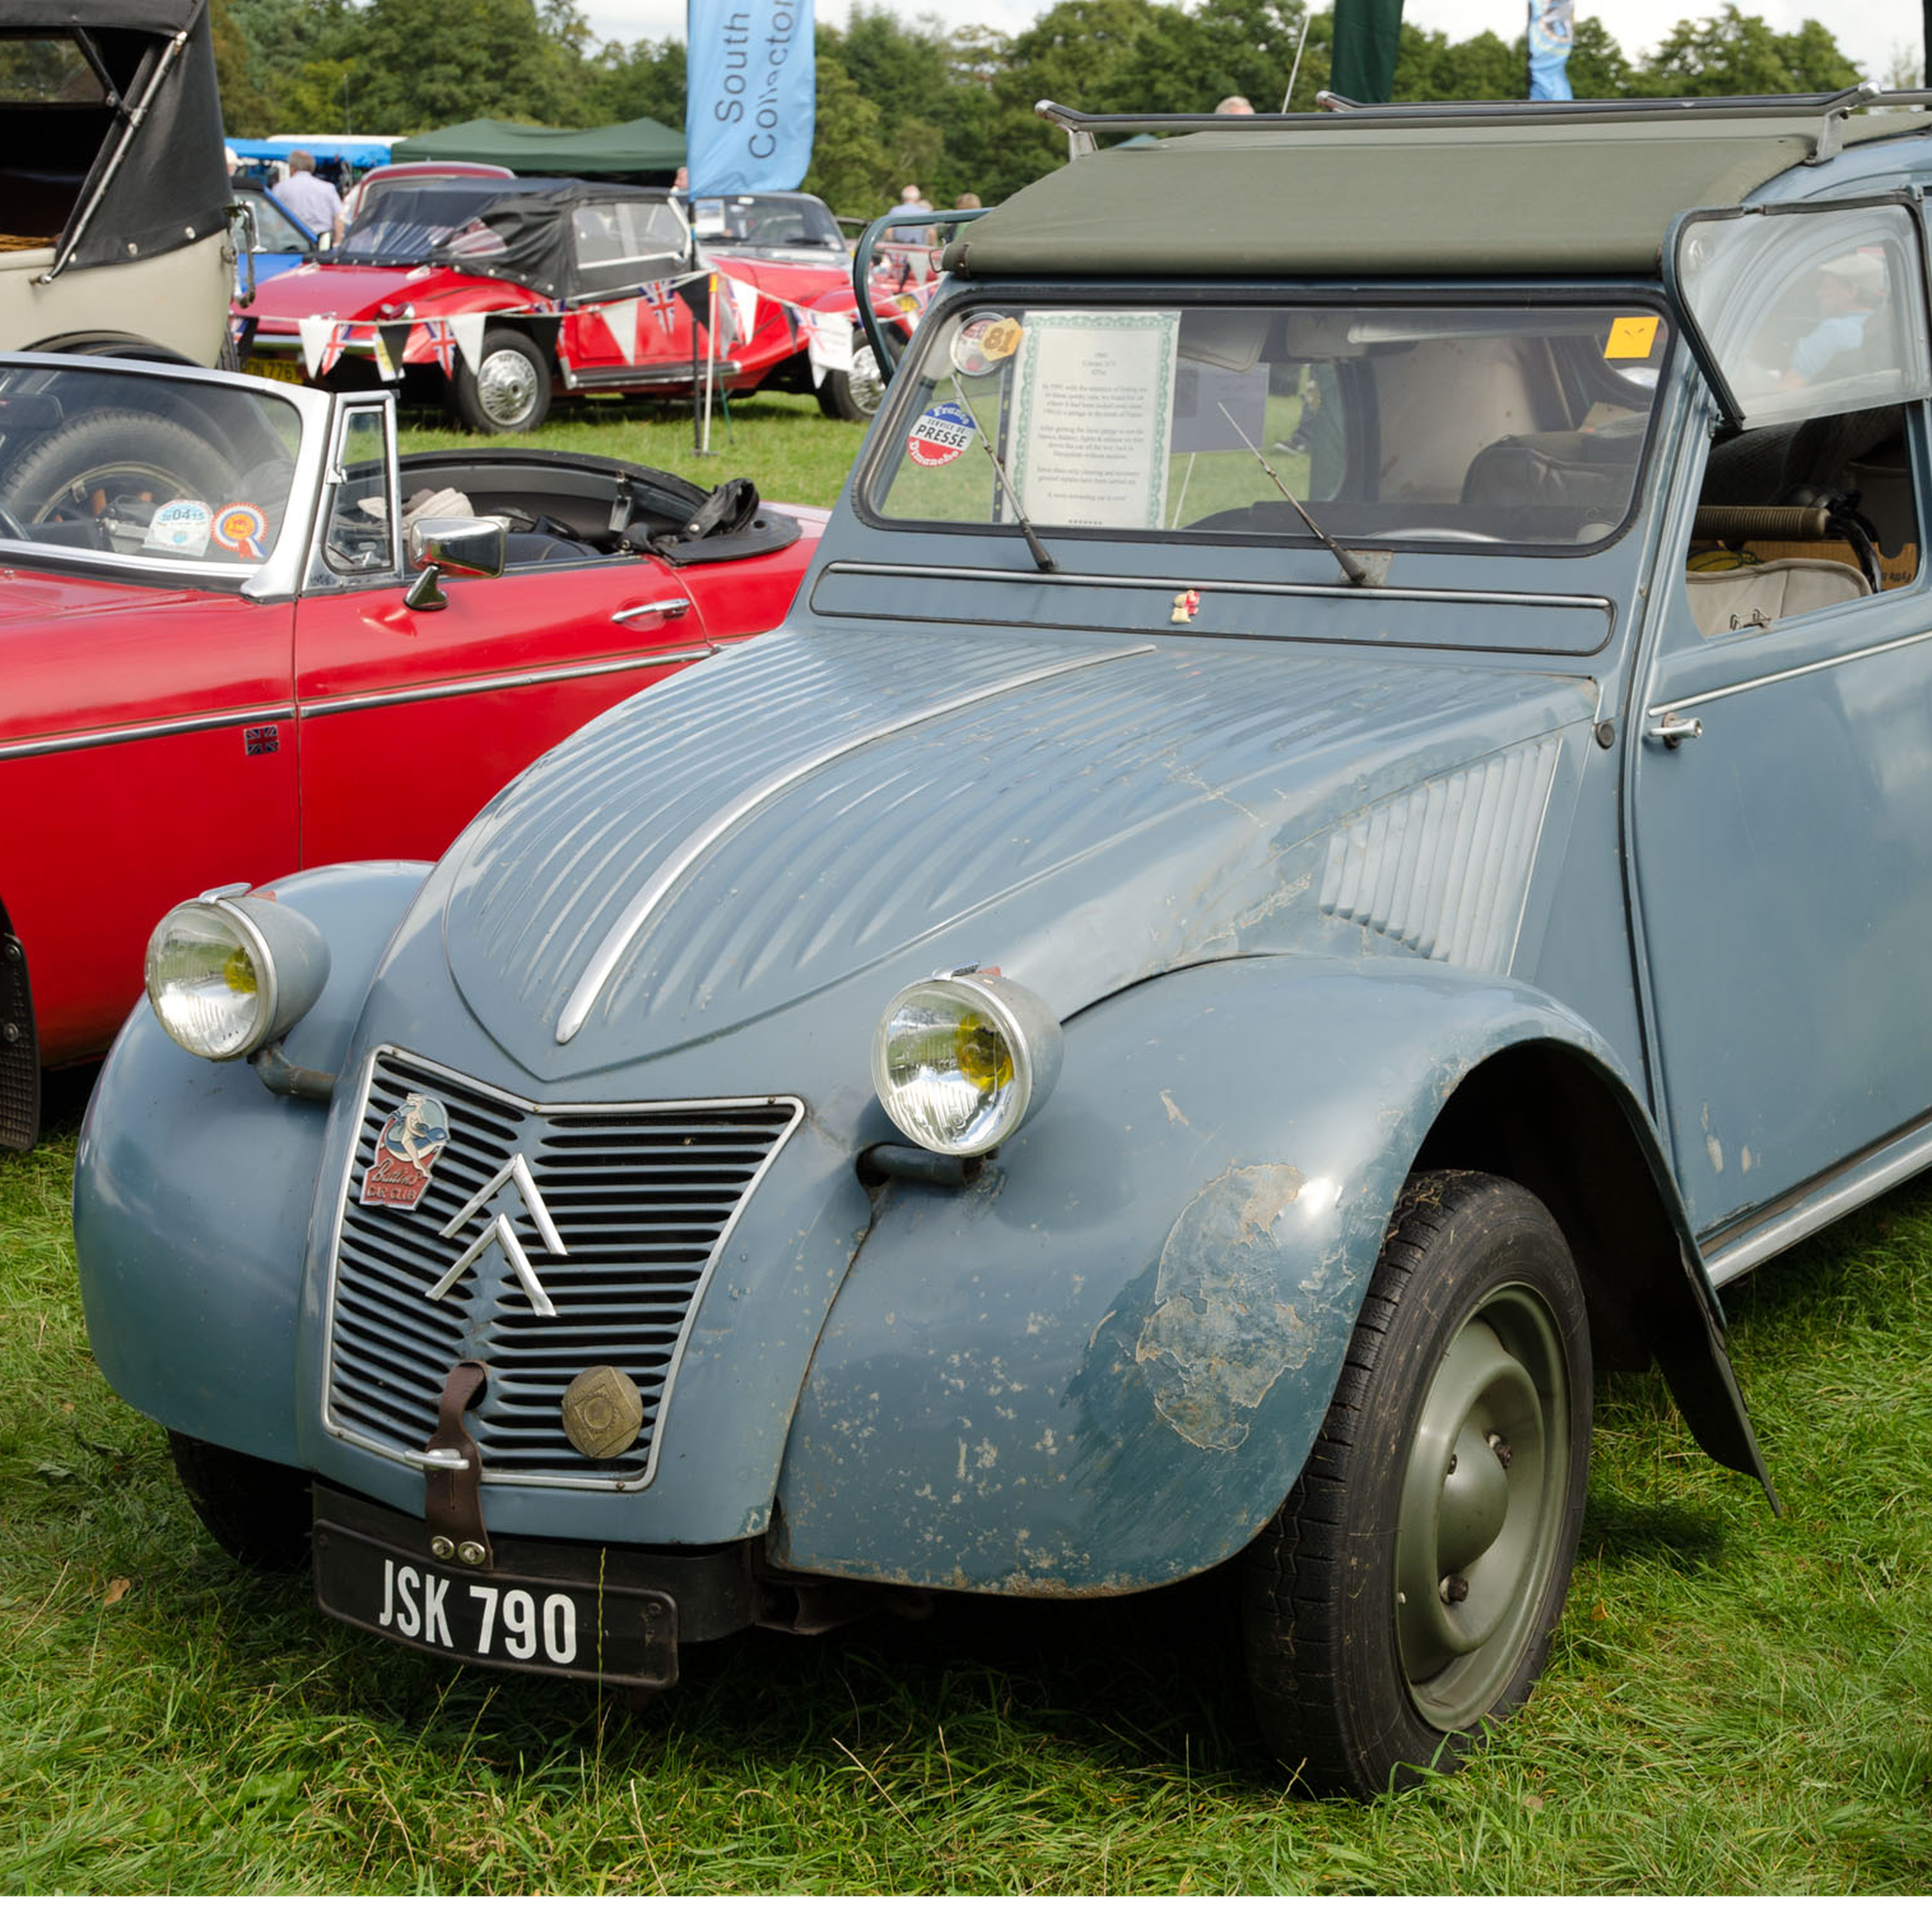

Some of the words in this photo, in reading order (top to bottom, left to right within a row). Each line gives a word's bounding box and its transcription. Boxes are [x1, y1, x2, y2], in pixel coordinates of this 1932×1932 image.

[714, 12, 750, 123] South
[915, 424, 967, 448] PRESSE
[390, 1189, 415, 1200] CLUB
[379, 1558, 454, 1649] JSK
[469, 1585, 577, 1665] 790
